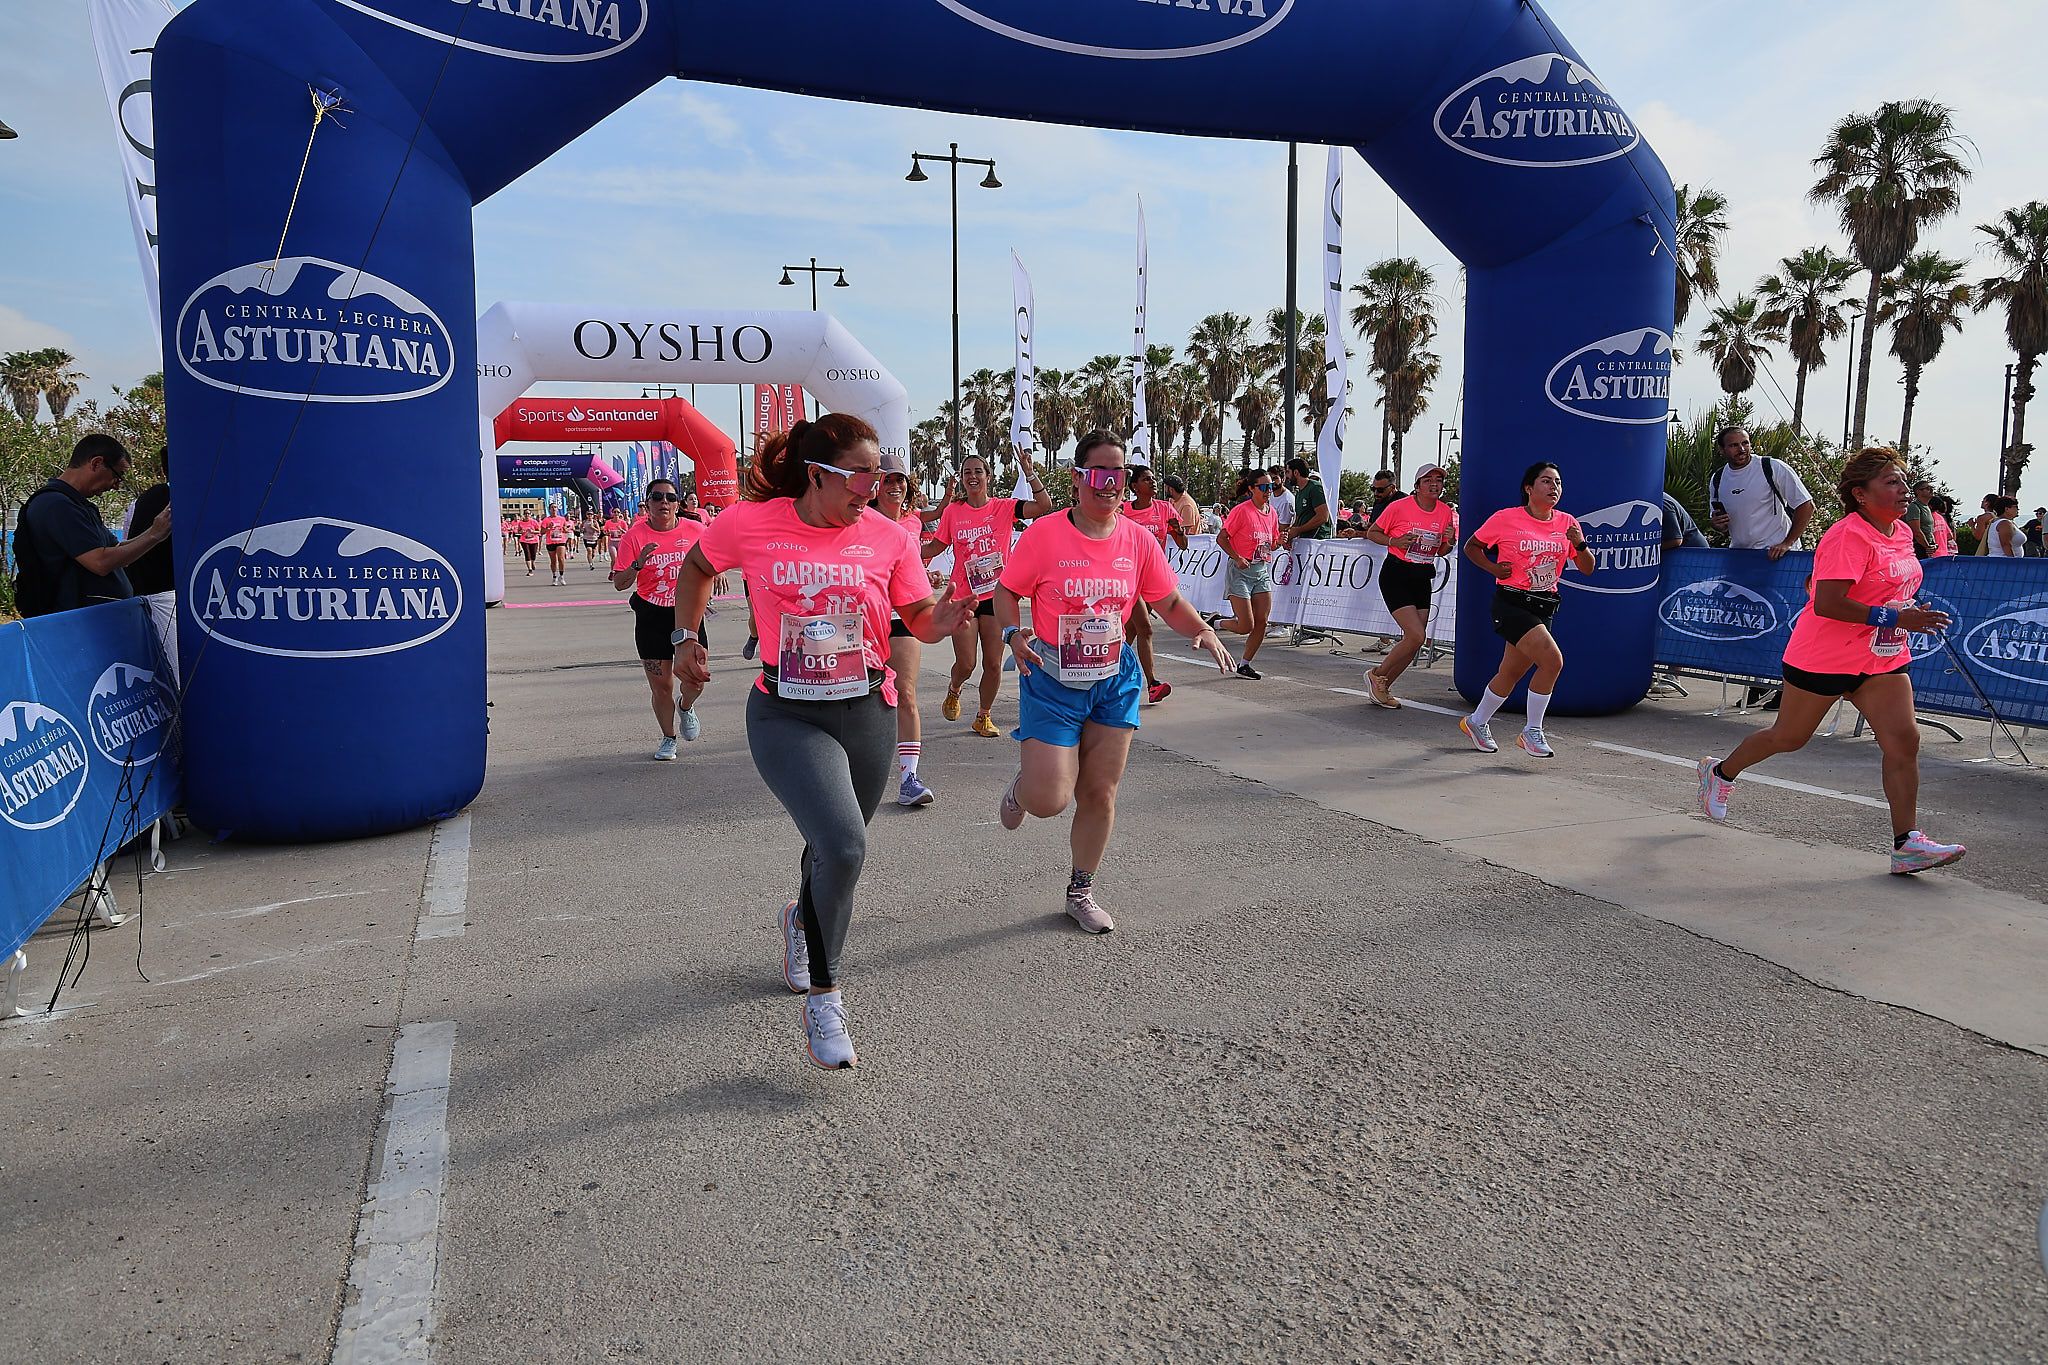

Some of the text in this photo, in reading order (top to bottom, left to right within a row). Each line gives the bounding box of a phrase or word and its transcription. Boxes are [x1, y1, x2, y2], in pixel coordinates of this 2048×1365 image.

[1498, 91, 1568, 103] CENTRAL
[1451, 96, 1635, 138] ASTURIANA
[225, 304, 433, 336] CENTRAL LECHERA
[189, 309, 441, 377] ASTURIANA
[573, 319, 773, 364] OYSHO
[1597, 361, 1652, 371] CENTRAL
[826, 368, 880, 381] OYSHO
[1560, 364, 1670, 400] ASTURIA
[518, 408, 659, 424] Sports Santander
[710, 469, 730, 478] Sports
[957, 524, 993, 540] CARRERA
[1585, 531, 1640, 543] CENTRAL
[766, 542, 808, 552] OYSHO
[979, 537, 992, 553] DE
[1520, 540, 1563, 553] CARRERA
[1058, 559, 1090, 568] OYSHO
[1168, 547, 1222, 578] YSHO
[238, 565, 441, 580] CENTRAL LECHERA
[772, 560, 866, 587] CARRERA
[1271, 553, 1374, 590] OYSHO
[202, 568, 450, 621] ASTURIANA
[1064, 578, 1131, 598] CARRERA
[1666, 597, 1765, 630] ASTURIANA
[1083, 644, 1109, 656] 016
[804, 653, 838, 669] 016
[787, 686, 860, 696] OYSHO Santander
